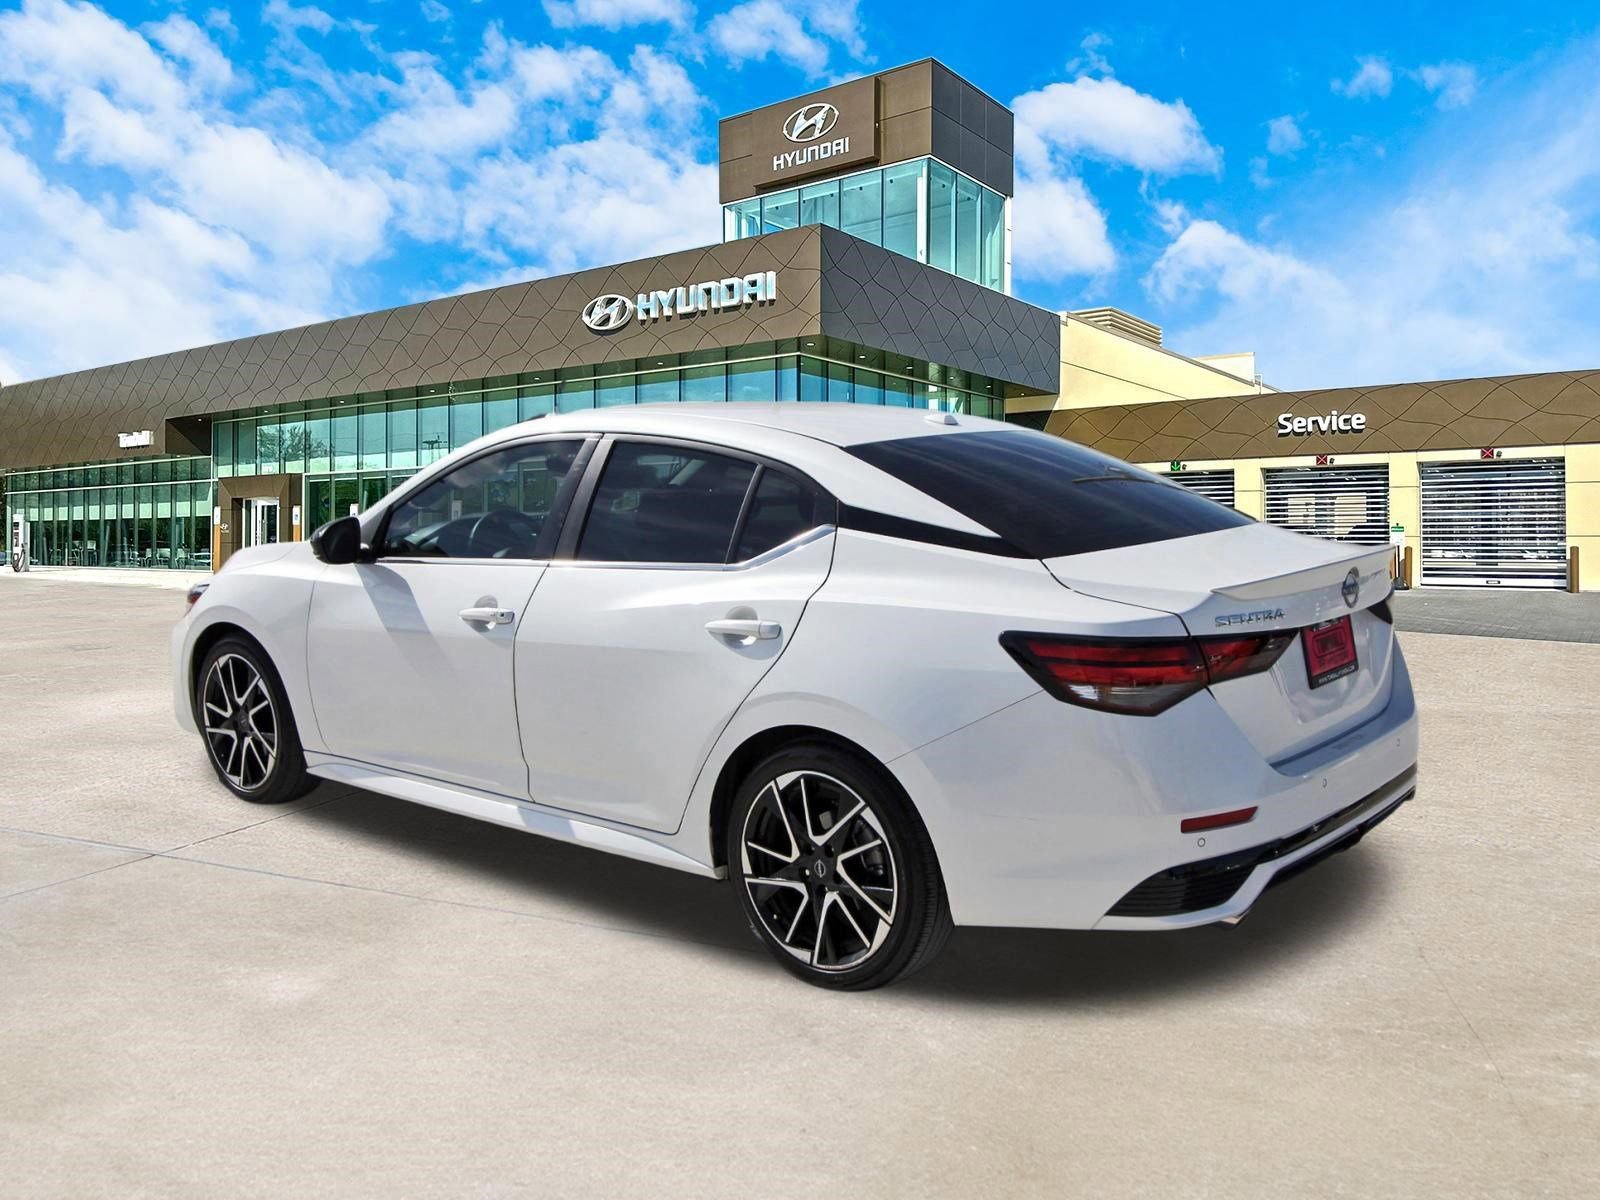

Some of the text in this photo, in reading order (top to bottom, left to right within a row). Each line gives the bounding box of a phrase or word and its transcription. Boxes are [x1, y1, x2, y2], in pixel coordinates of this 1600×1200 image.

[773, 136, 850, 171] HYUNDAI
[636, 270, 777, 321] HYUNDAI
[1277, 410, 1366, 435] Service
